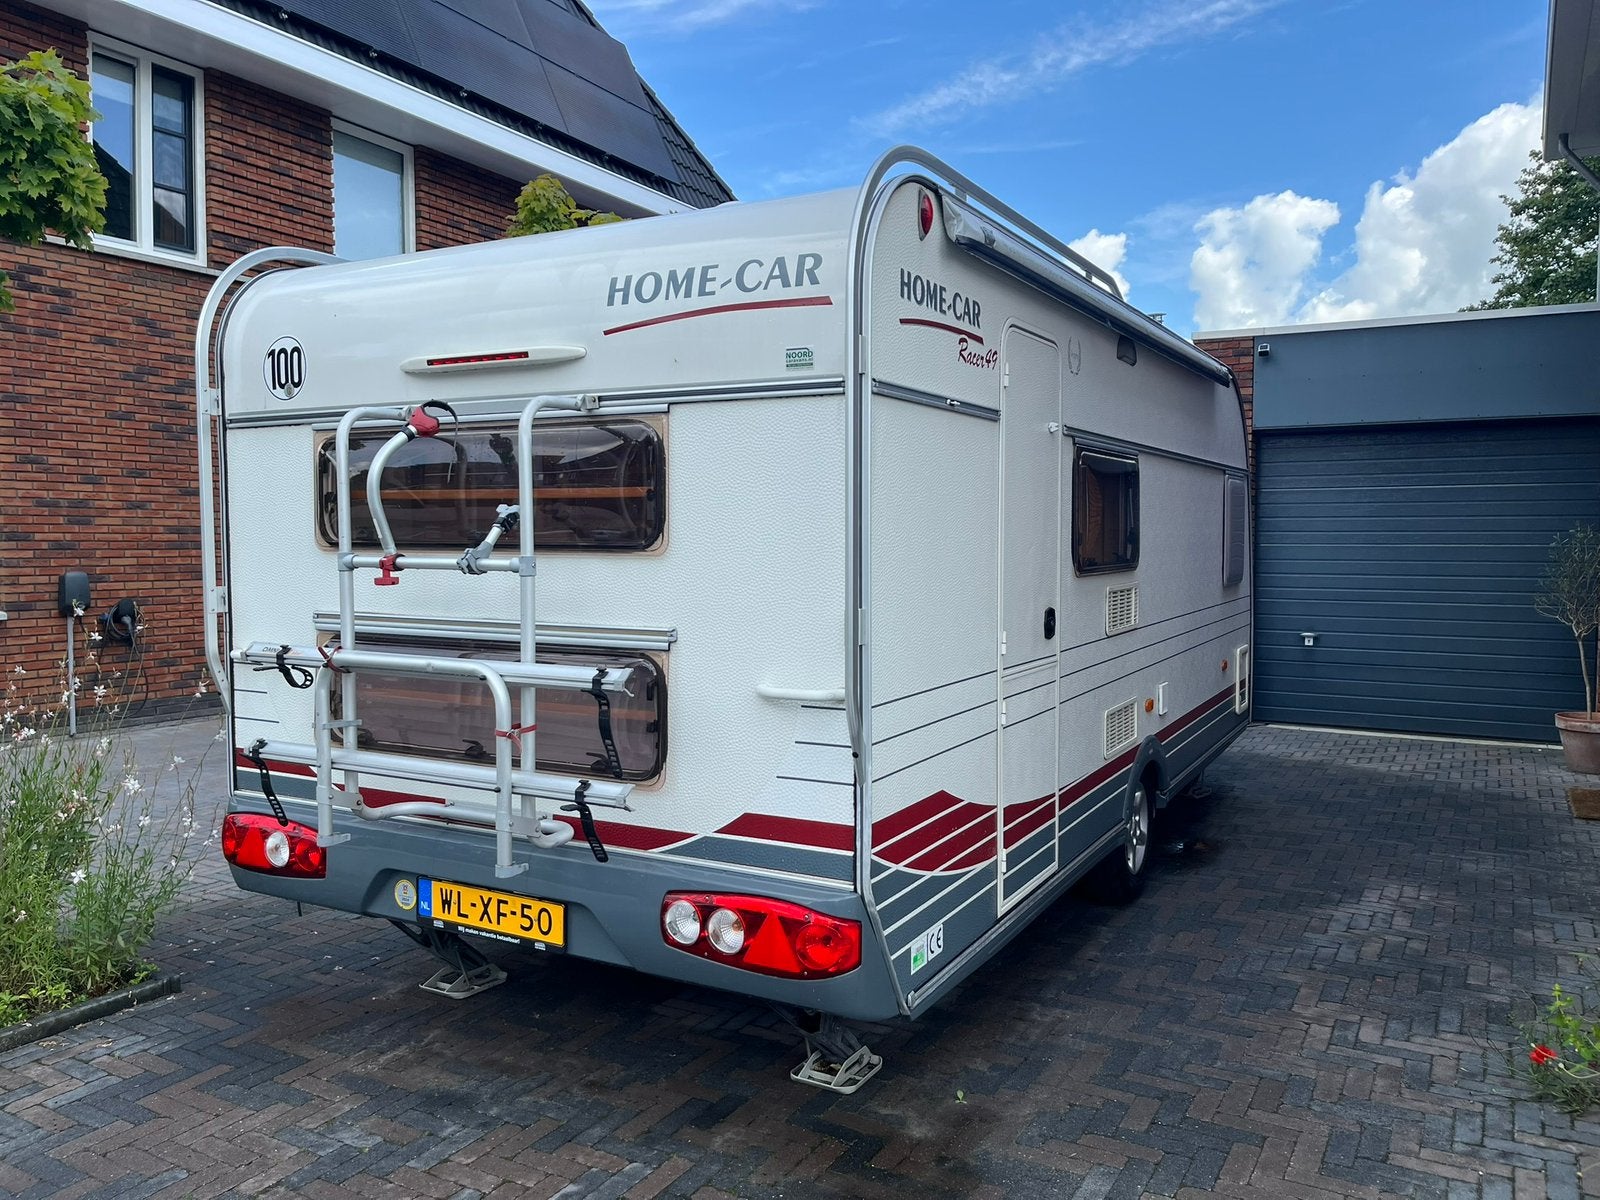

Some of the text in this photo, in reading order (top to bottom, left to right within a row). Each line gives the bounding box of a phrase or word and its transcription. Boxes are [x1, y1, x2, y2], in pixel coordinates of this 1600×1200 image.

[606, 252, 823, 307] HOME-CAR
[900, 267, 981, 329] HOME-CAR
[267, 346, 303, 390] 100
[785, 350, 813, 359] NOORD
[420, 900, 431, 910] NL
[440, 887, 553, 936] WL-XF-50
